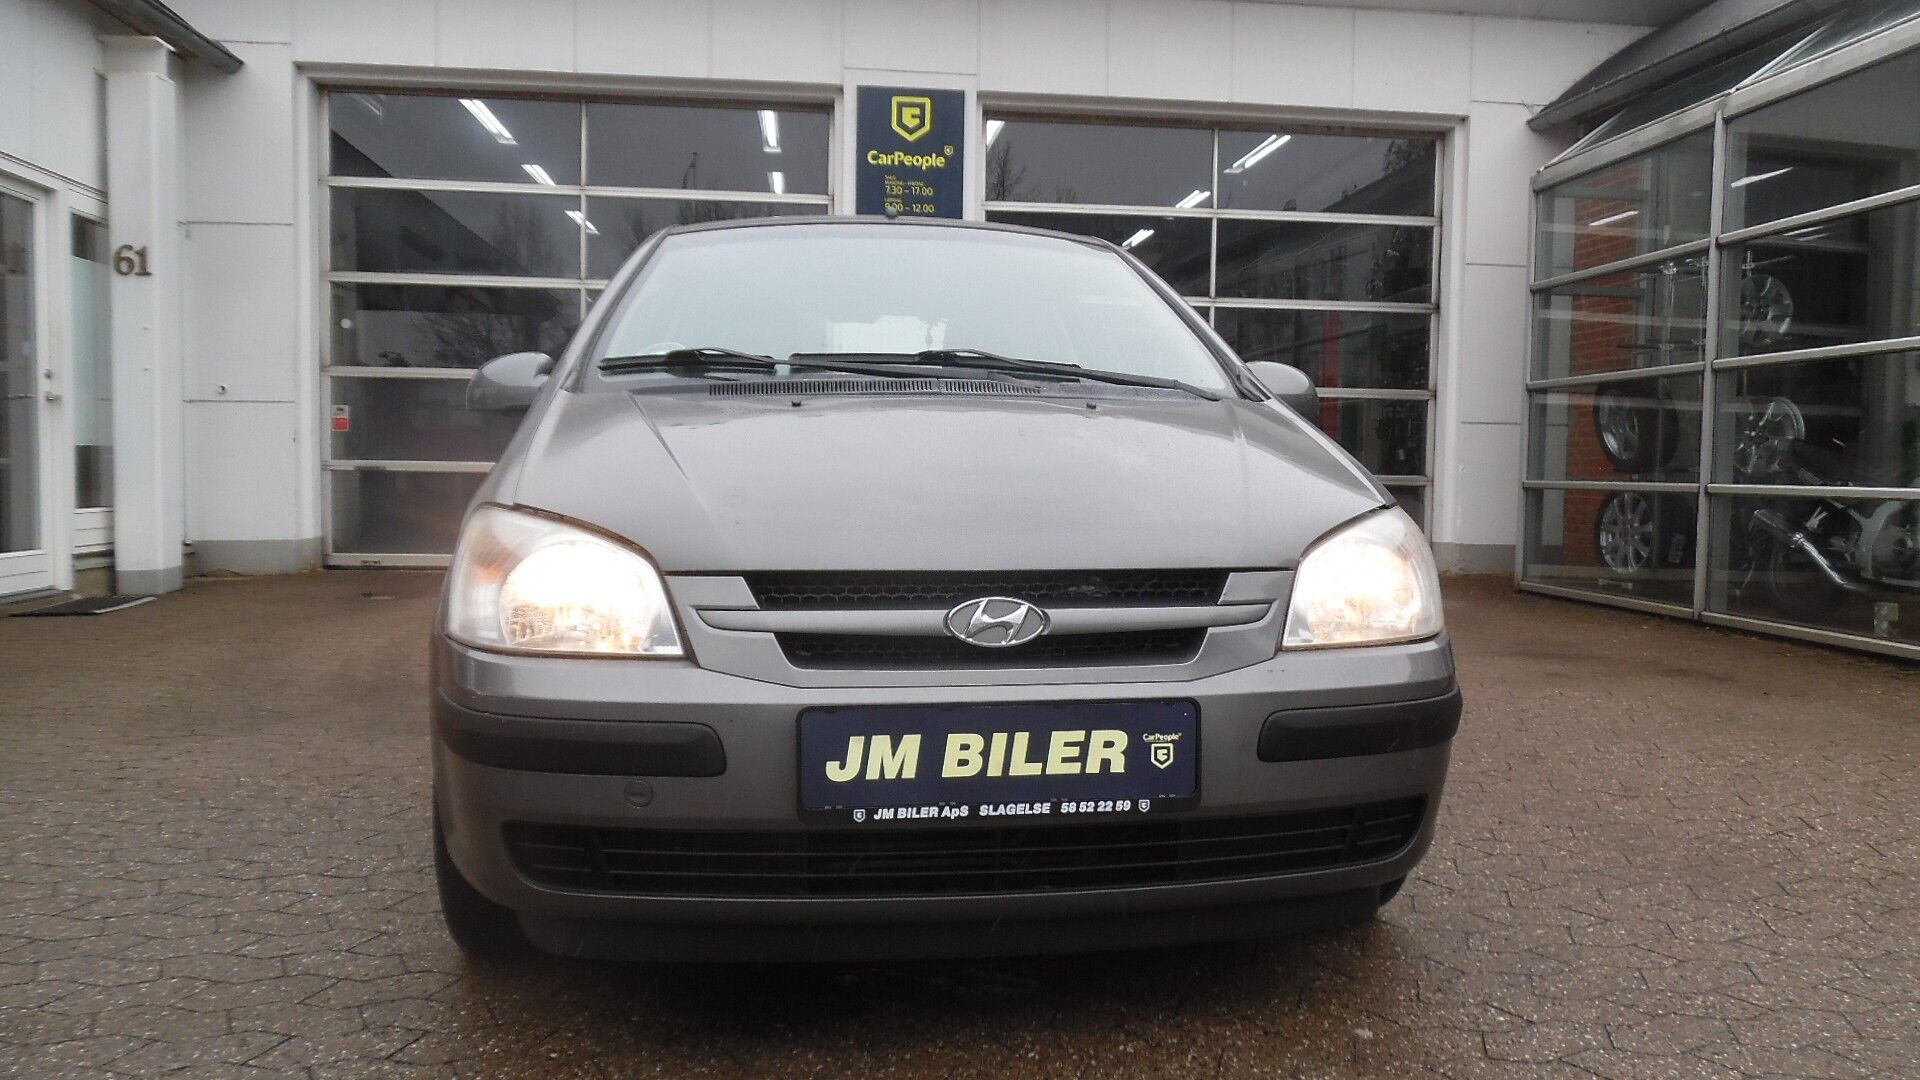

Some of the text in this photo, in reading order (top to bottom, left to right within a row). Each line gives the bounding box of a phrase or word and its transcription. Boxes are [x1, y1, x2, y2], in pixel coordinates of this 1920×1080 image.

[867, 150, 945, 170] CarPeople
[911, 186, 934, 197] 17.00
[884, 202, 904, 212] 900
[912, 203, 935, 213] 12.00
[113, 244, 152, 276] 61
[1142, 733, 1179, 742] CarPeople
[825, 729, 1129, 782] JM BILER
[873, 800, 1132, 820] JM BILER ApS SLAGELSE 58 52 22 59
